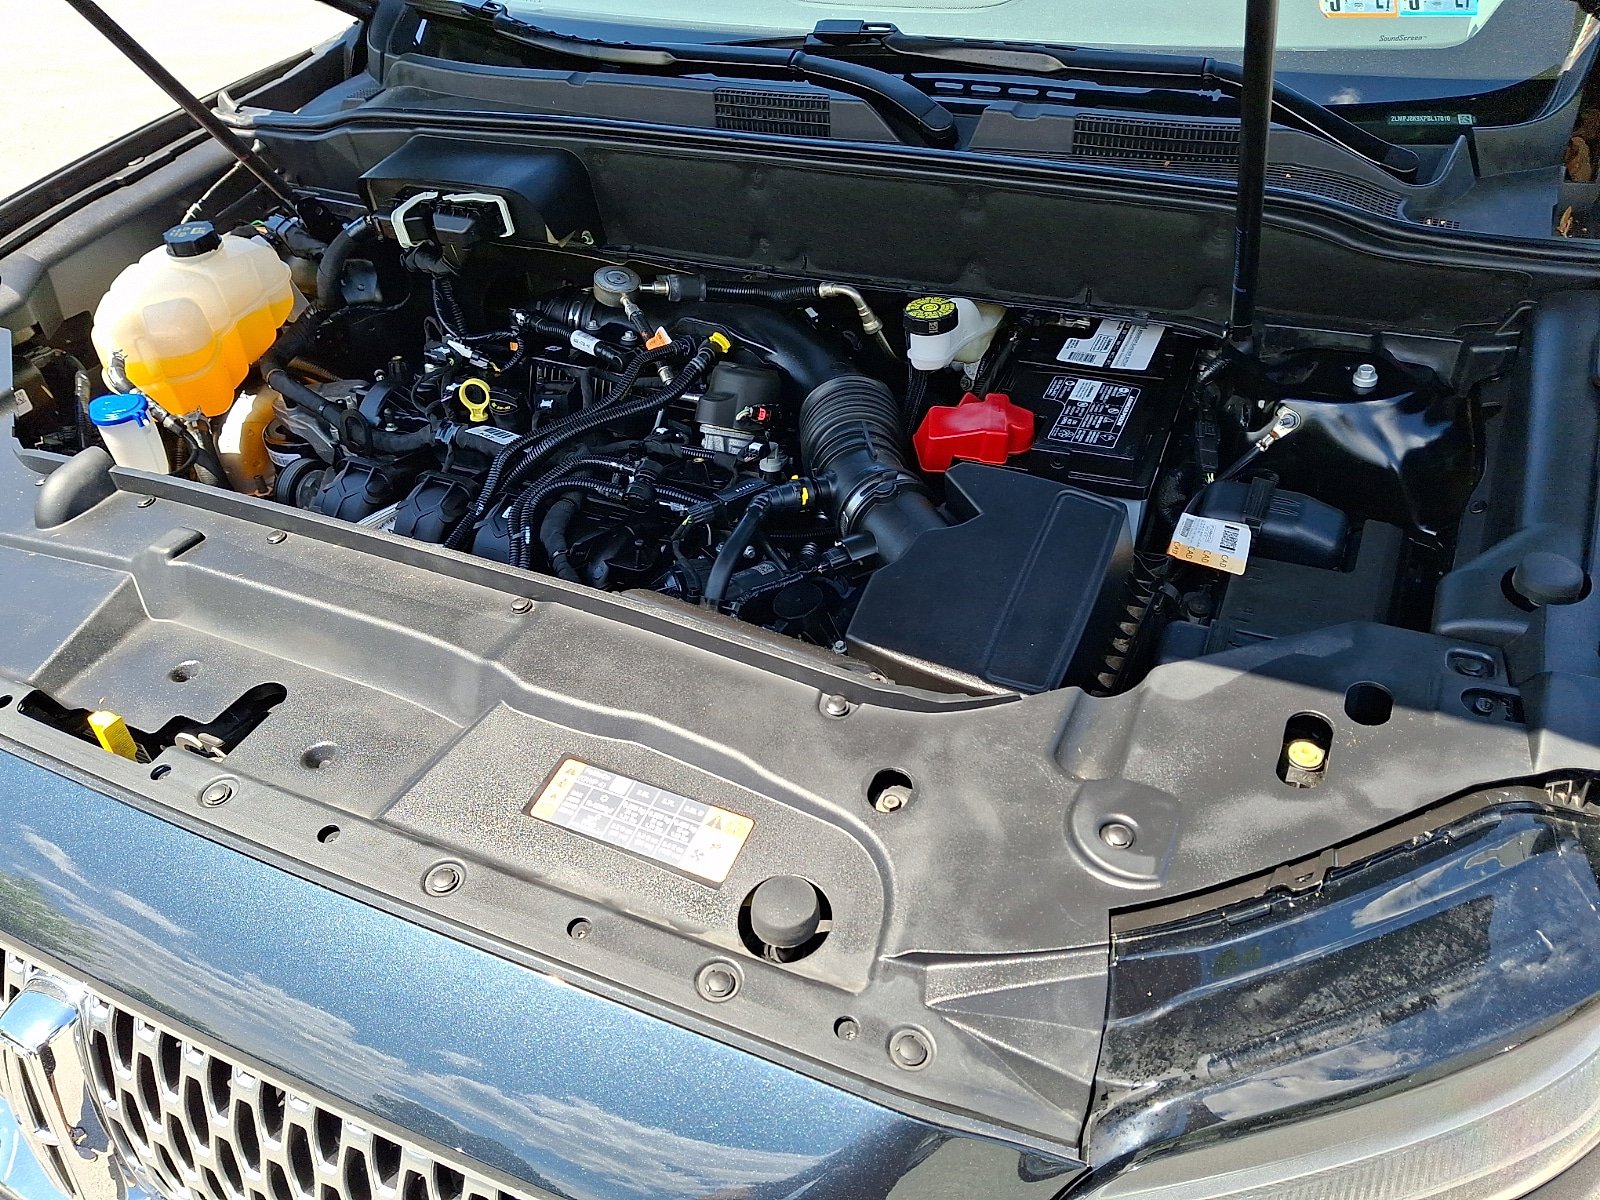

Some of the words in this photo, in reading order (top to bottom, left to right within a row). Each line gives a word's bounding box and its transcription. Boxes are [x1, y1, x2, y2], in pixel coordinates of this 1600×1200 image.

[1185, 546, 1196, 560] CAD
[1201, 549, 1212, 564] CAD
[1219, 554, 1229, 568] CAD
